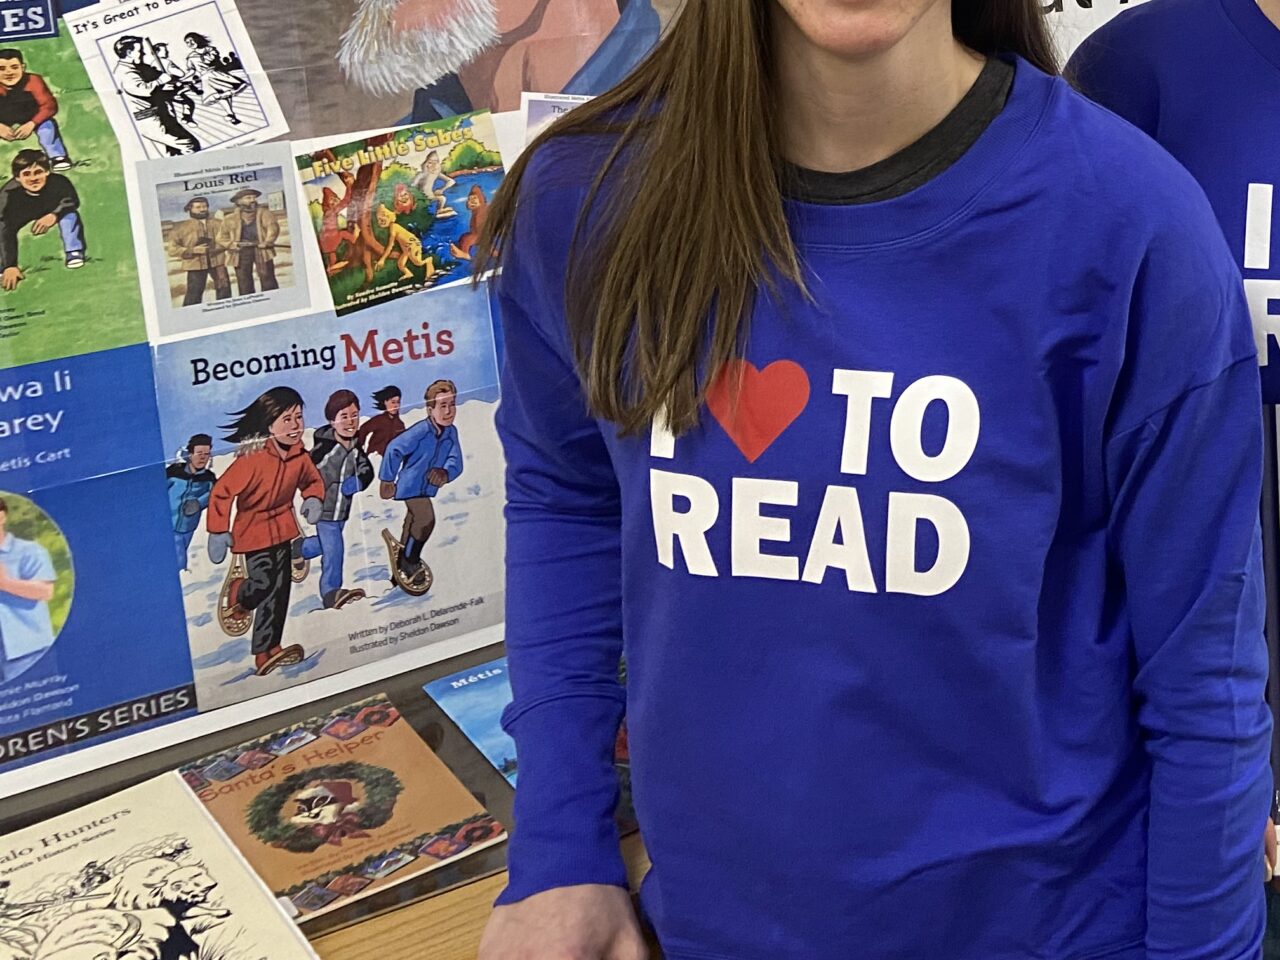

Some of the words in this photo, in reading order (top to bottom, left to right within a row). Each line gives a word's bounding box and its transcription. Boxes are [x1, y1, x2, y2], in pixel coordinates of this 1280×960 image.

[73, 19, 99, 35] It's
[103, 6, 140, 26] Great
[145, 1, 160, 13] to
[183, 176, 224, 192] Louis
[229, 170, 259, 185] Riel
[312, 157, 354, 179] Five
[357, 139, 411, 167] Little
[1243, 182, 1273, 270] I
[190, 342, 337, 386] Becoming
[340, 321, 455, 373] Metis
[0, 380, 43, 402] wa
[54, 370, 72, 392] li
[832, 368, 980, 482] TO
[0, 455, 31, 472] etis
[35, 448, 71, 464] Cart
[650, 468, 970, 596] READ
[450, 664, 502, 689] Métis
[0, 717, 90, 758] REN'S
[98, 689, 190, 732] SERIES
[198, 763, 296, 803] Santa's
[302, 730, 386, 765] Helper
[0, 846, 34, 864] alo
[39, 808, 132, 848] Hunters
